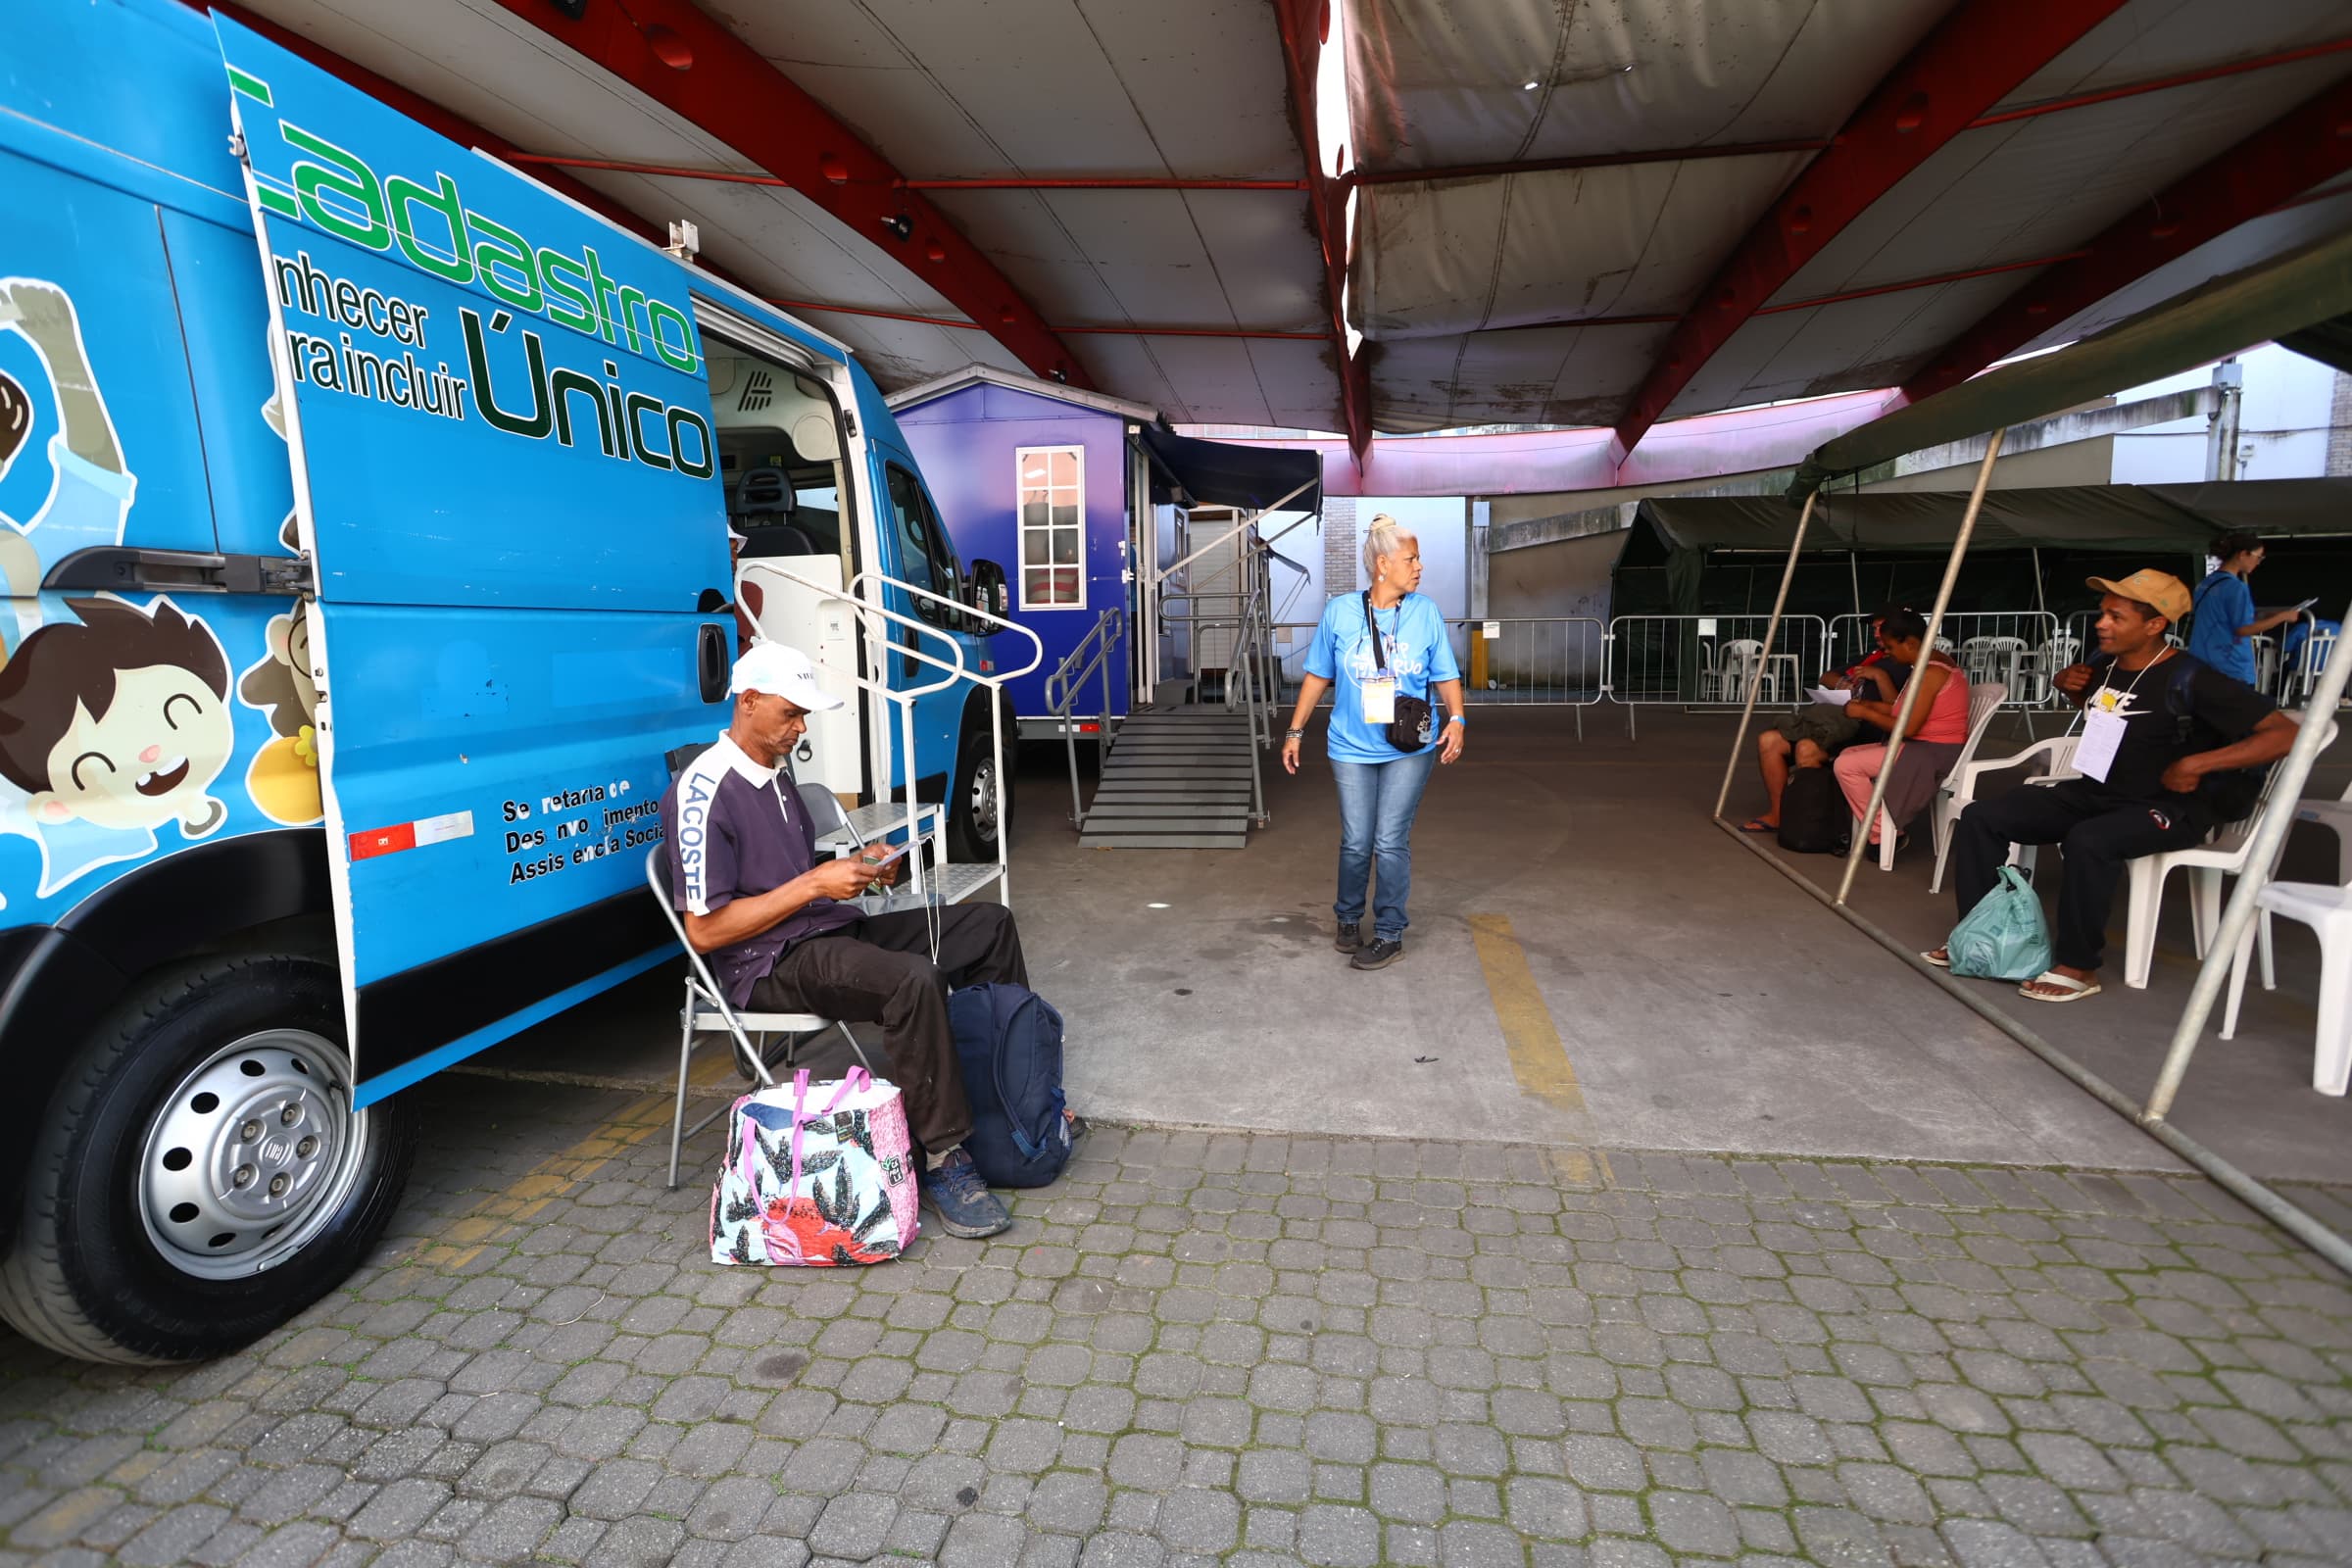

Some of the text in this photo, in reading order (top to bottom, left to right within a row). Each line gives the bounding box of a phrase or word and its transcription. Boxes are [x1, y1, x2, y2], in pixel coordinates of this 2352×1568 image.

[226, 63, 698, 374] adastro
[274, 251, 428, 350] nhecer
[343, 331, 466, 421] incluir
[459, 307, 714, 480] Único
[502, 784, 606, 823] Seretaria
[679, 772, 716, 901] LACOSTE
